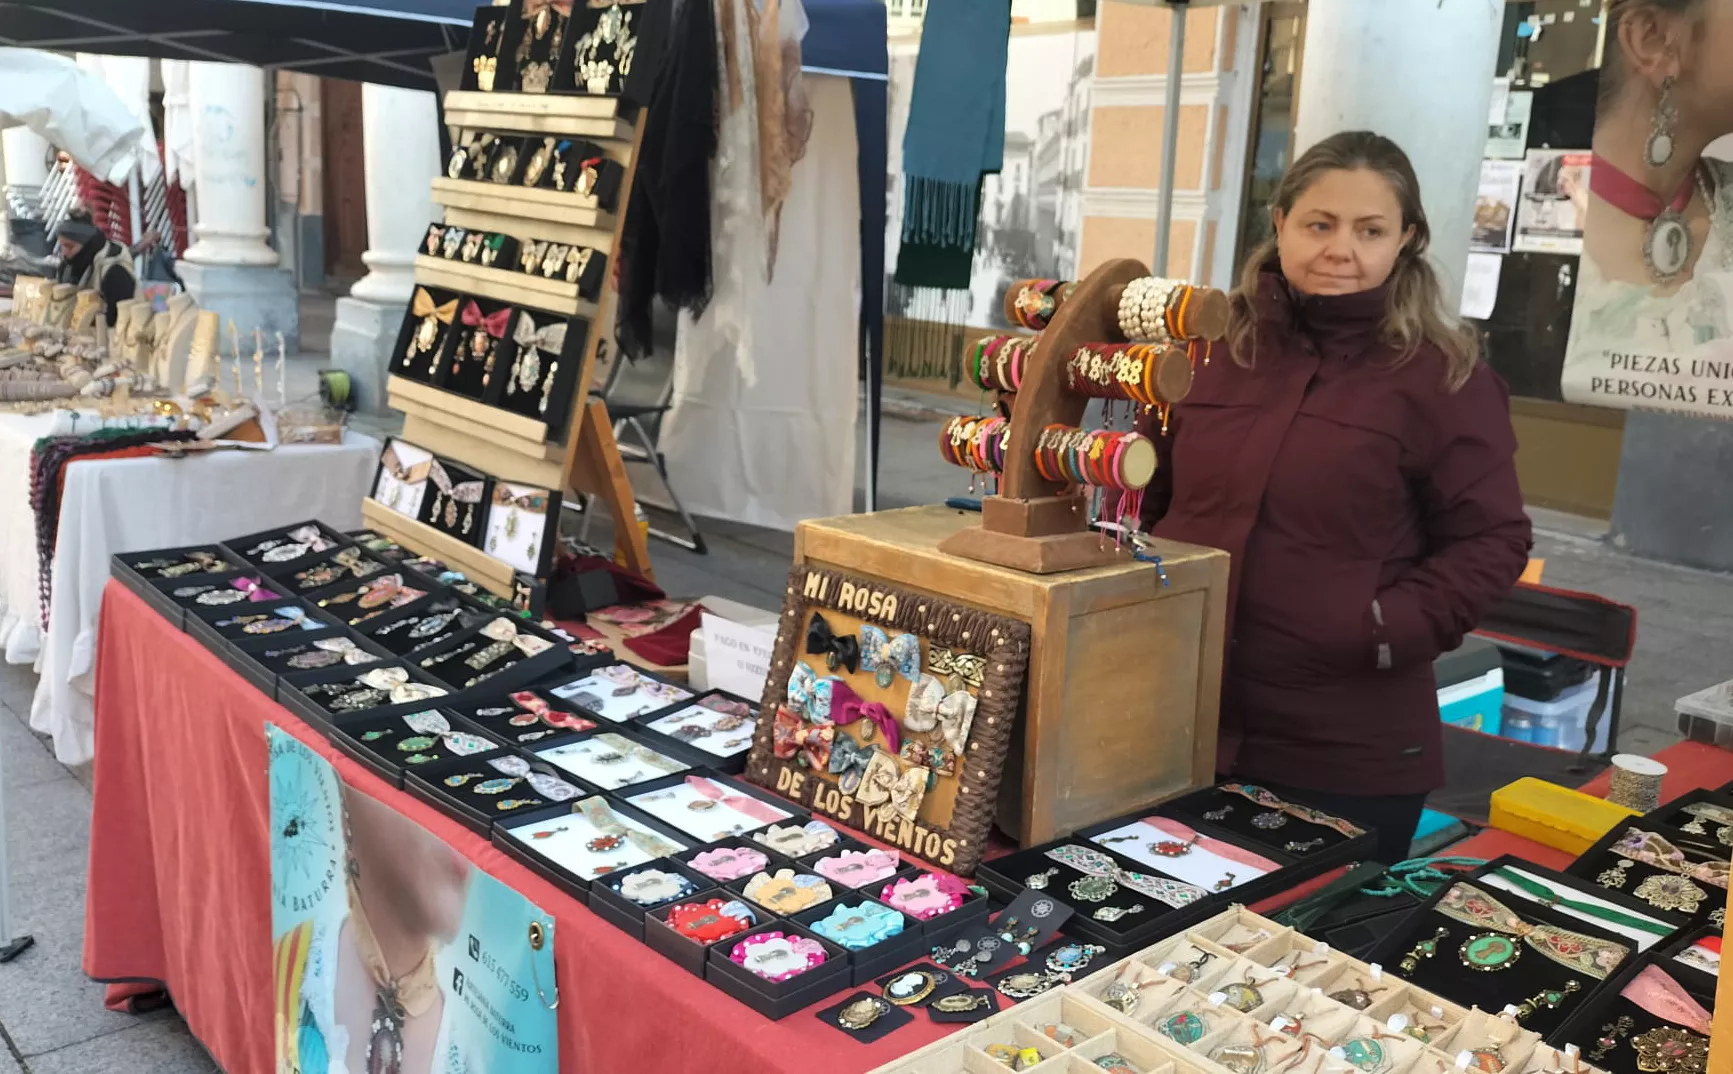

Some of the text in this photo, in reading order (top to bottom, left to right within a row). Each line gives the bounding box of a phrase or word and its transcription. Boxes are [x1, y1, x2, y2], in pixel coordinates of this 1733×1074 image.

[1602, 350, 1733, 380] "PIEZAS UNI
[1590, 377, 1697, 403] PERSONAS
[803, 571, 898, 622] MI ROSA
[776, 766, 958, 866] DE LOS VIENTOS
[293, 858, 338, 913] BATURRA
[509, 980, 529, 1002] 559
[501, 1034, 542, 1053] VIENTOS
